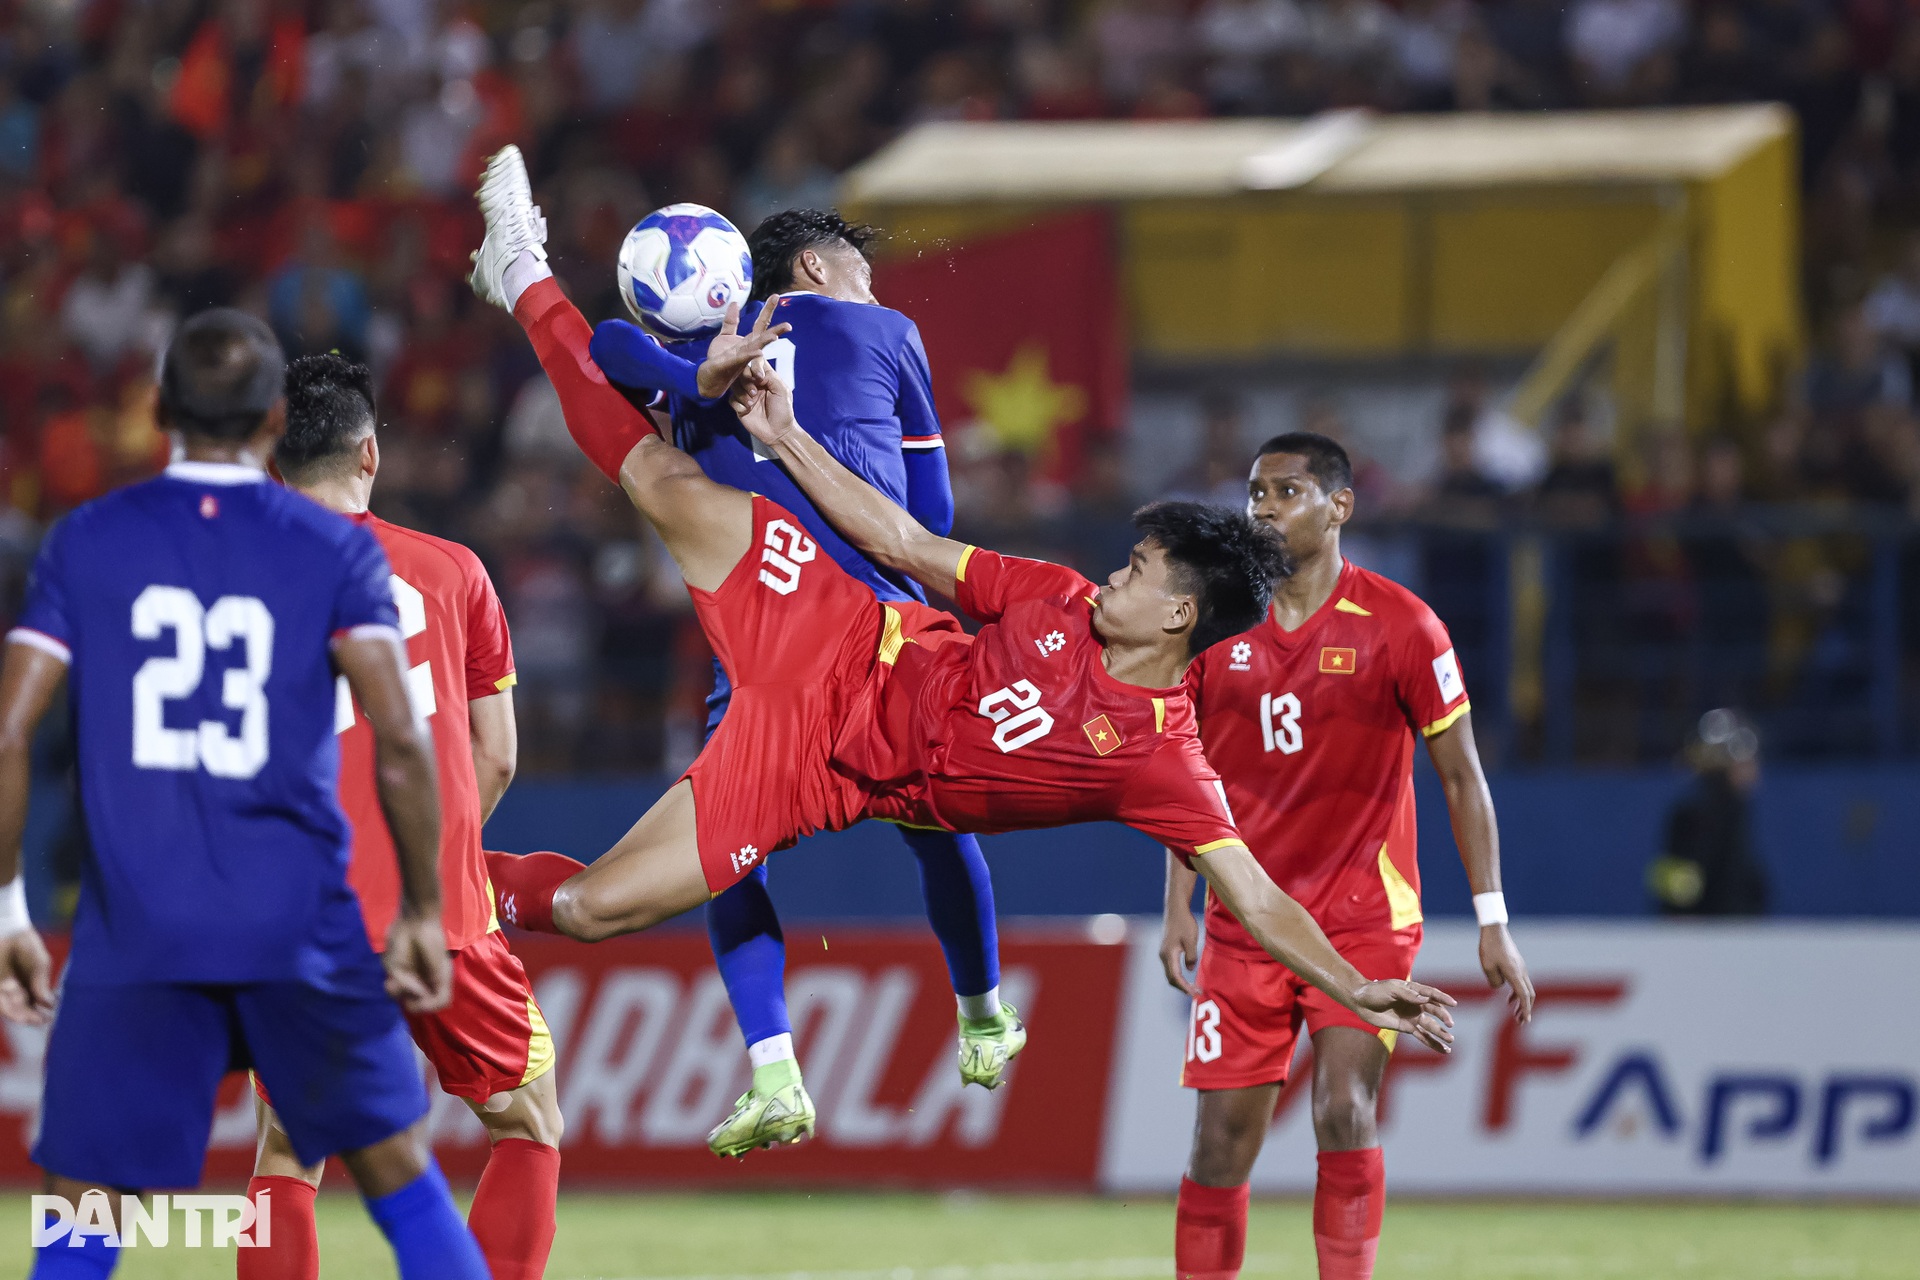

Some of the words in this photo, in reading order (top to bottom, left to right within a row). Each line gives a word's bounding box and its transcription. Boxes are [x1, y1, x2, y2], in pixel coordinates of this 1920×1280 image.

[758, 518, 817, 596] 20
[131, 585, 274, 780] 23
[978, 678, 1055, 754] 20
[1260, 691, 1304, 756] 13
[1187, 998, 1222, 1064] 13
